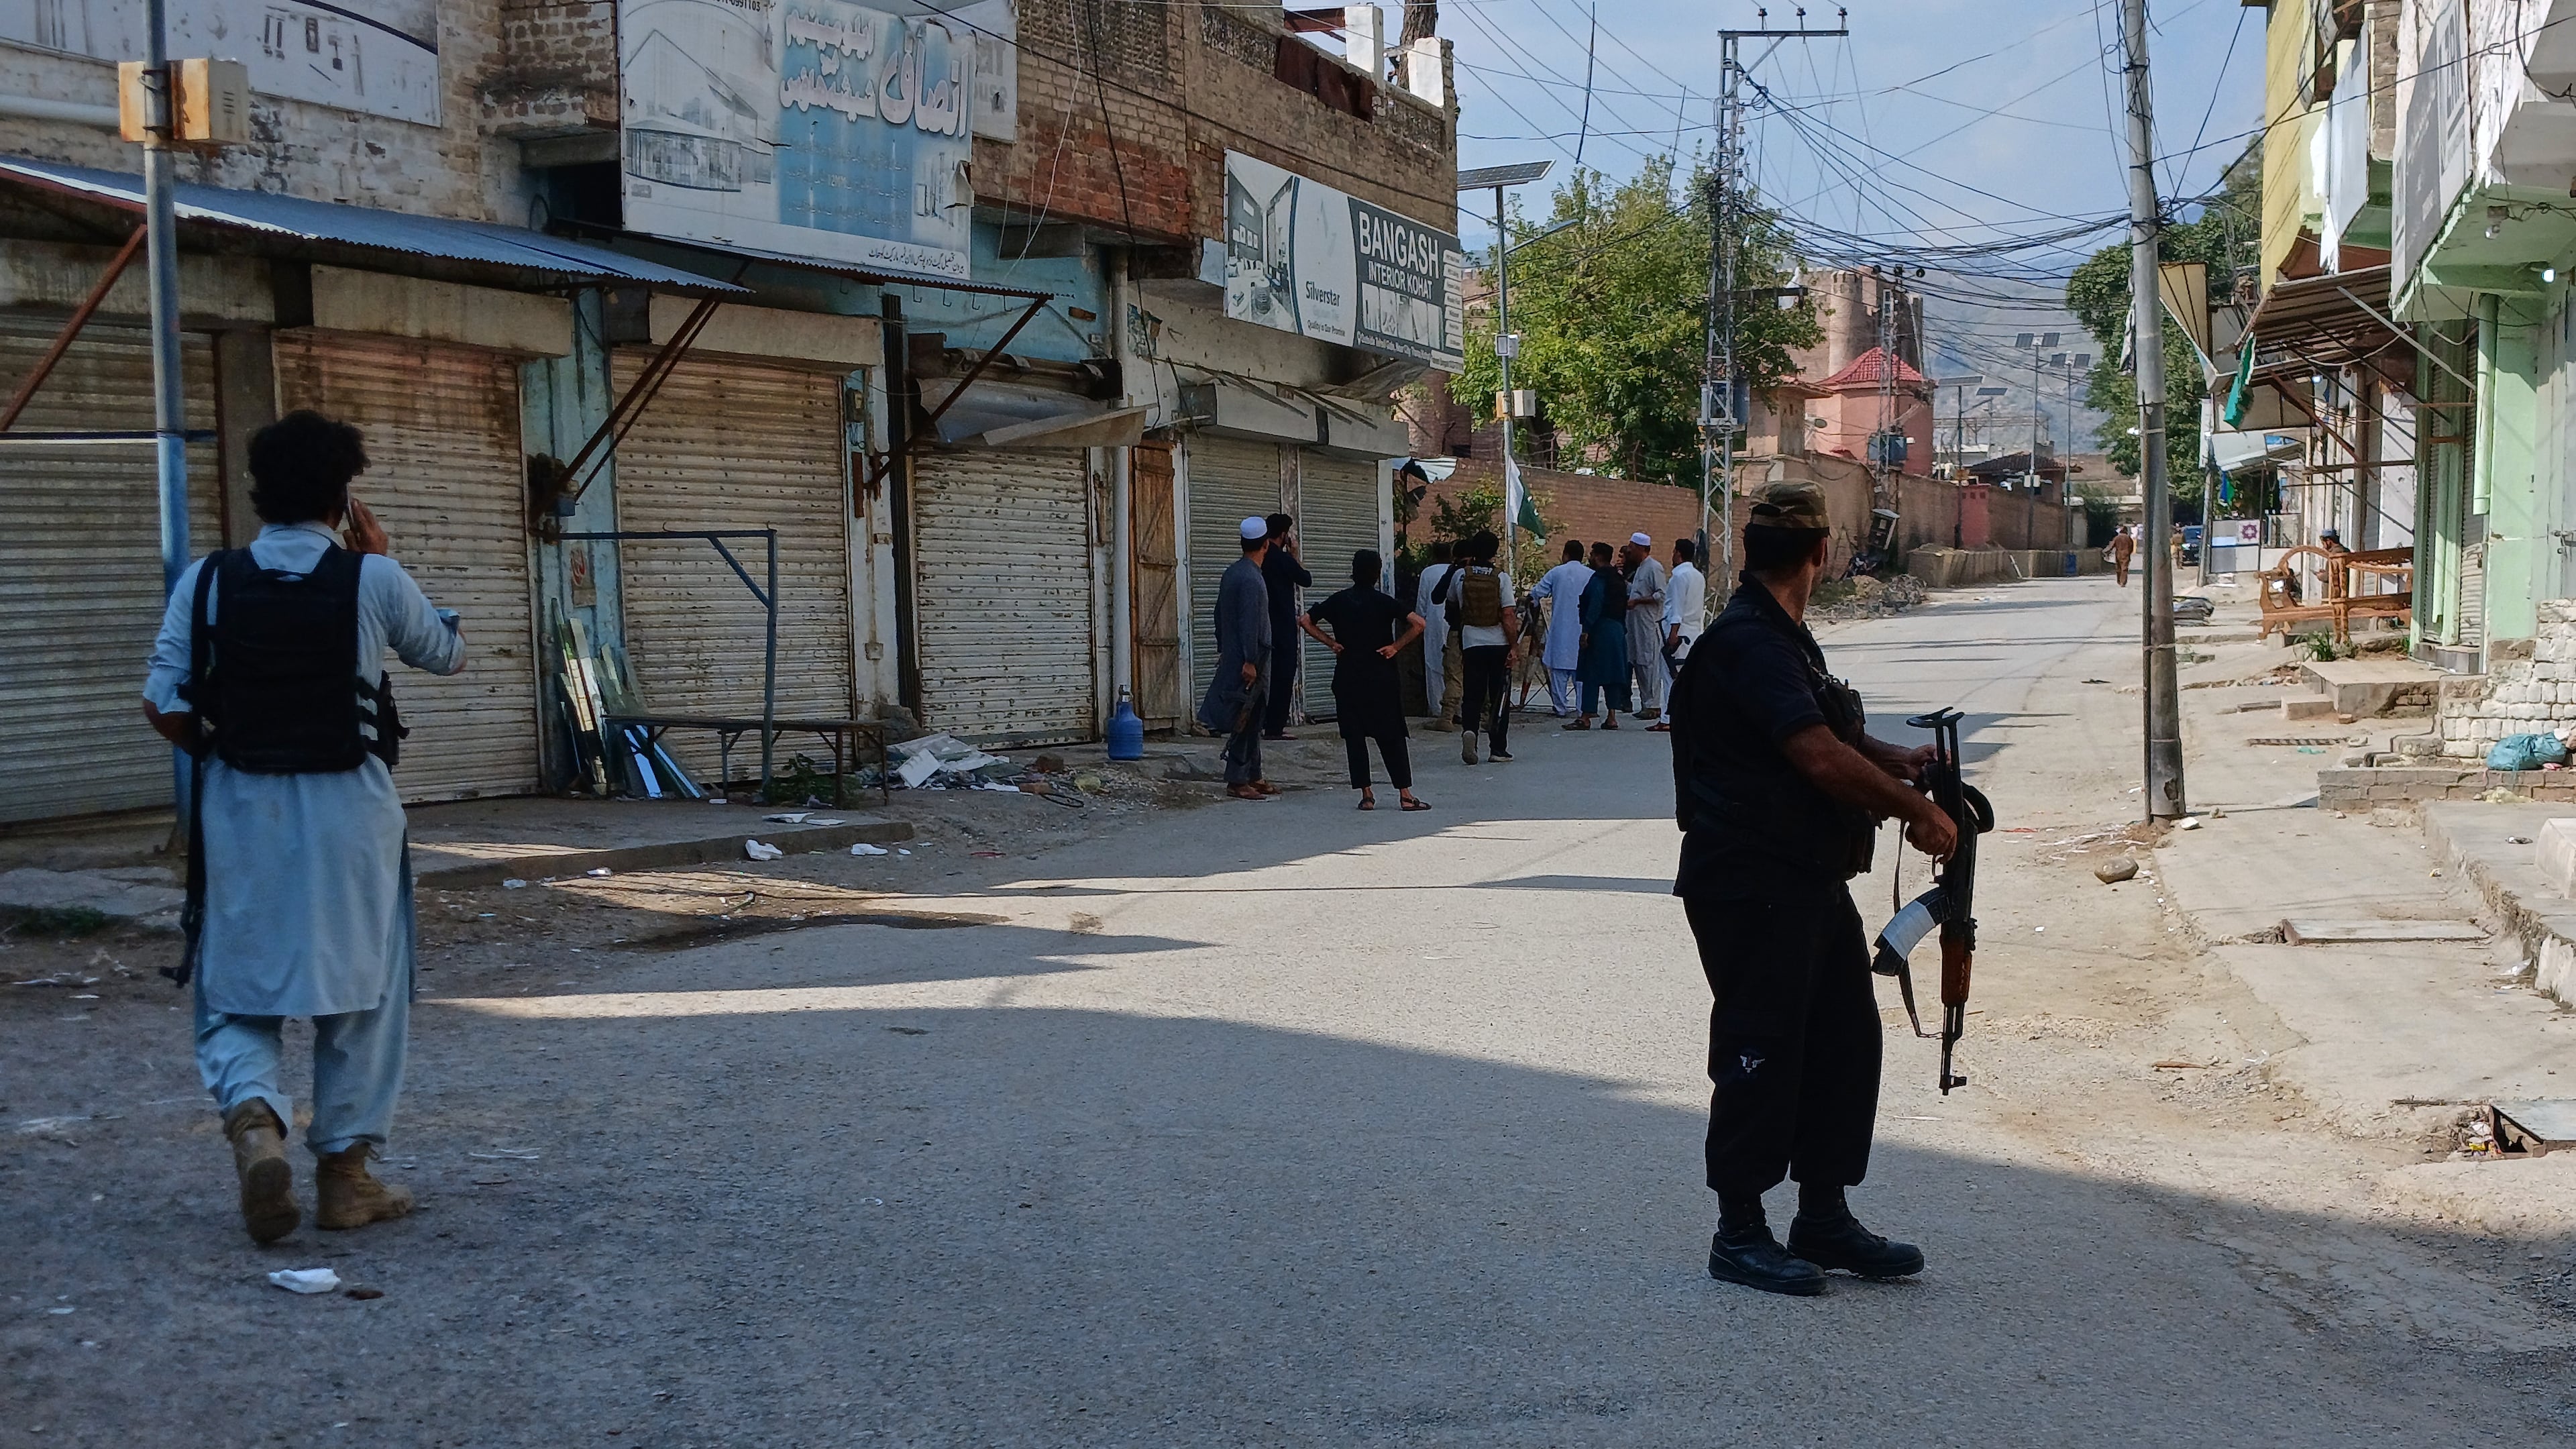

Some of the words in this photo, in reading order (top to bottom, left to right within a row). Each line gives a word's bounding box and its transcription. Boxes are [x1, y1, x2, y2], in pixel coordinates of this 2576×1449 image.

[879, 34, 969, 138] انصاف
[1358, 210, 1440, 279] BANGASH
[1305, 280, 1340, 307] Silverstar
[1368, 260, 1406, 291] INTERIOR
[1406, 272, 1433, 300] KOHAT
[1307, 319, 1321, 333] Quality
